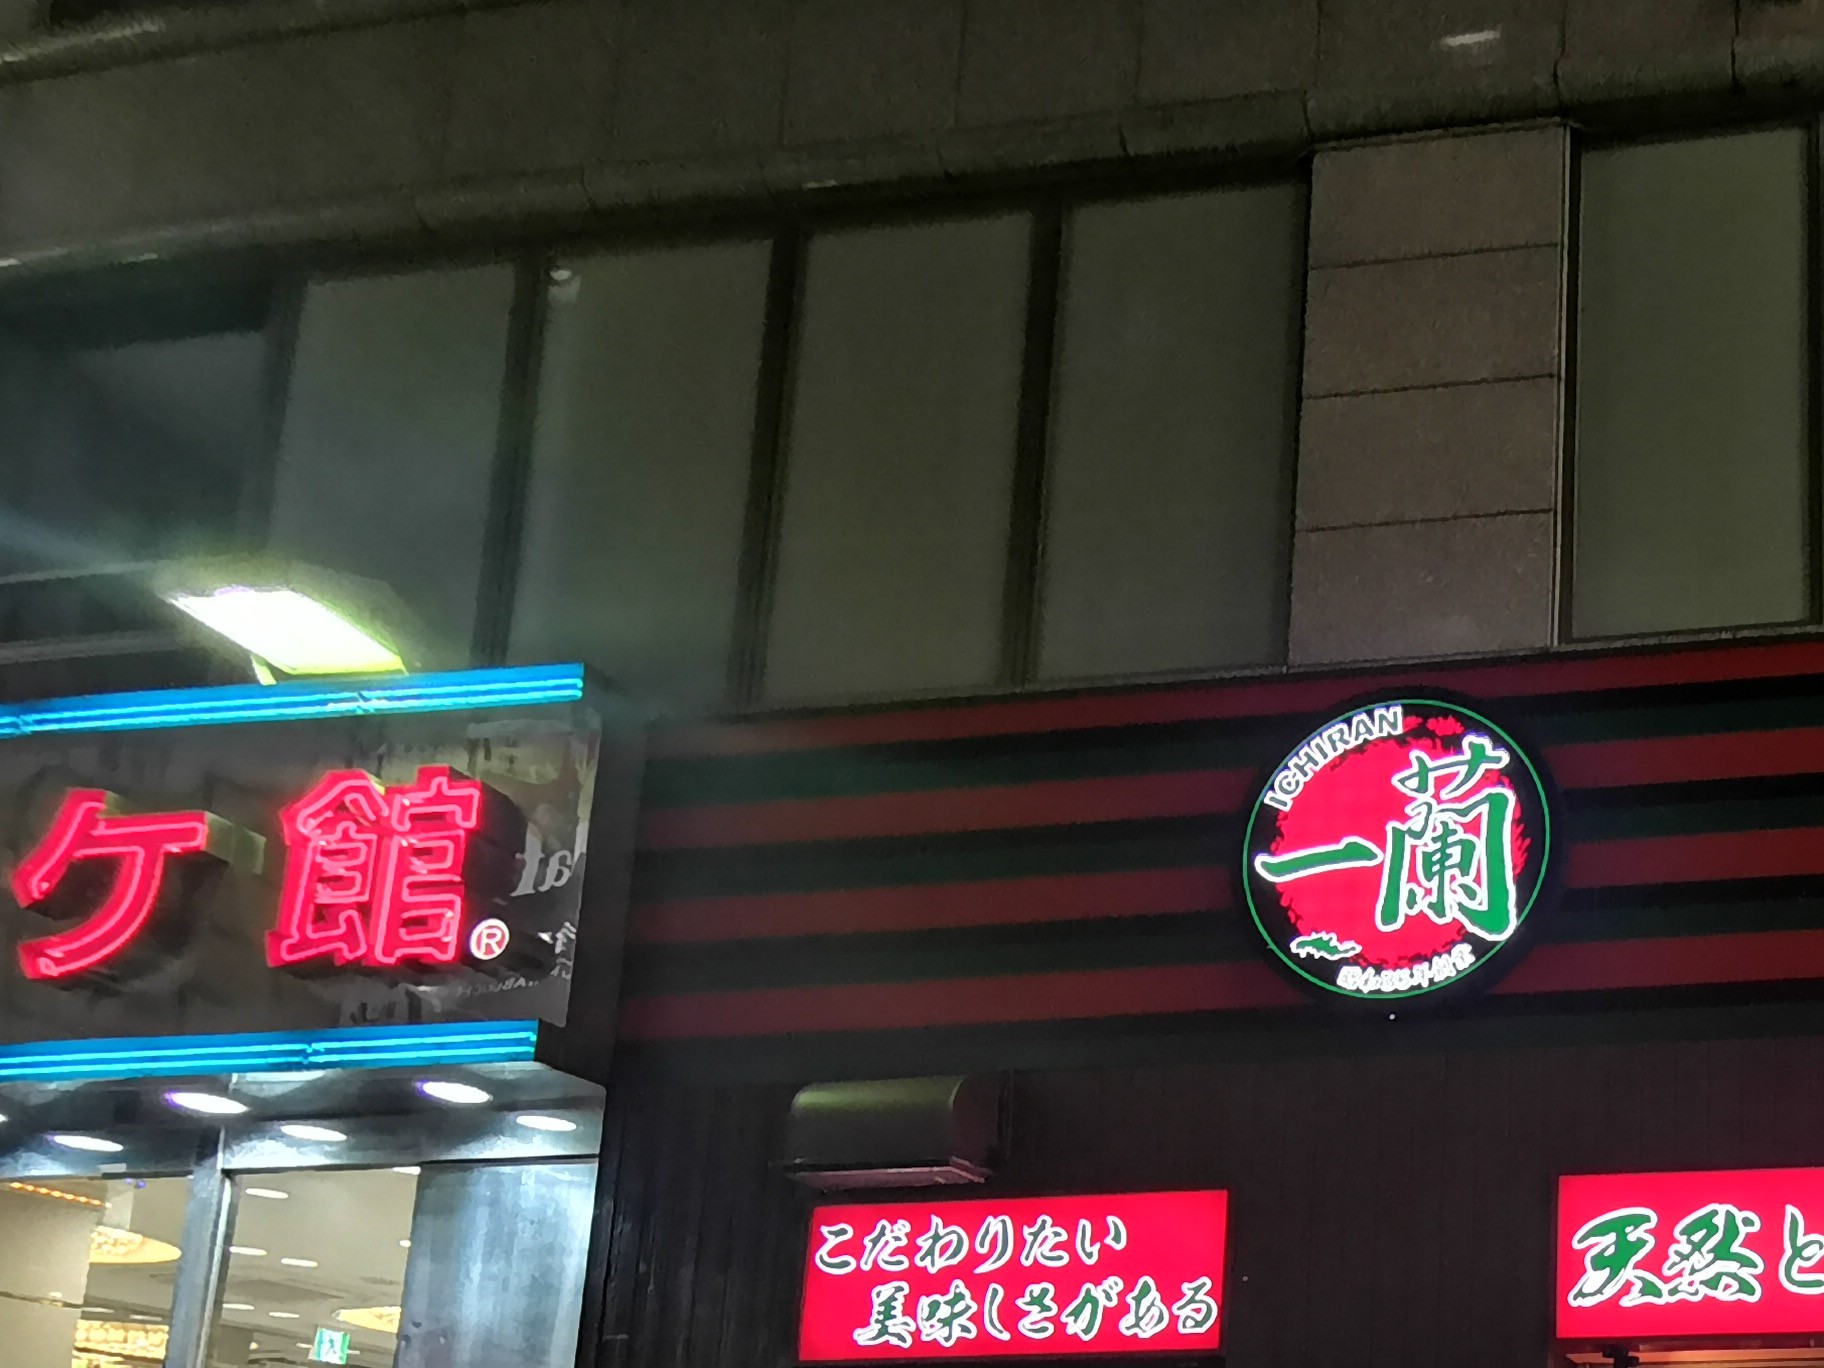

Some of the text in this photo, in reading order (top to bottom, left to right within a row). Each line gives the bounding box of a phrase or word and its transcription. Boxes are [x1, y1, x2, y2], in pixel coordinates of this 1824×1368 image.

[1263, 705, 1403, 812] ICHIRAN
[1255, 733, 1517, 941] 一蘭
[814, 1215, 1128, 1274] こだわりたい
[853, 1276, 1219, 1348] 美味しさがある
